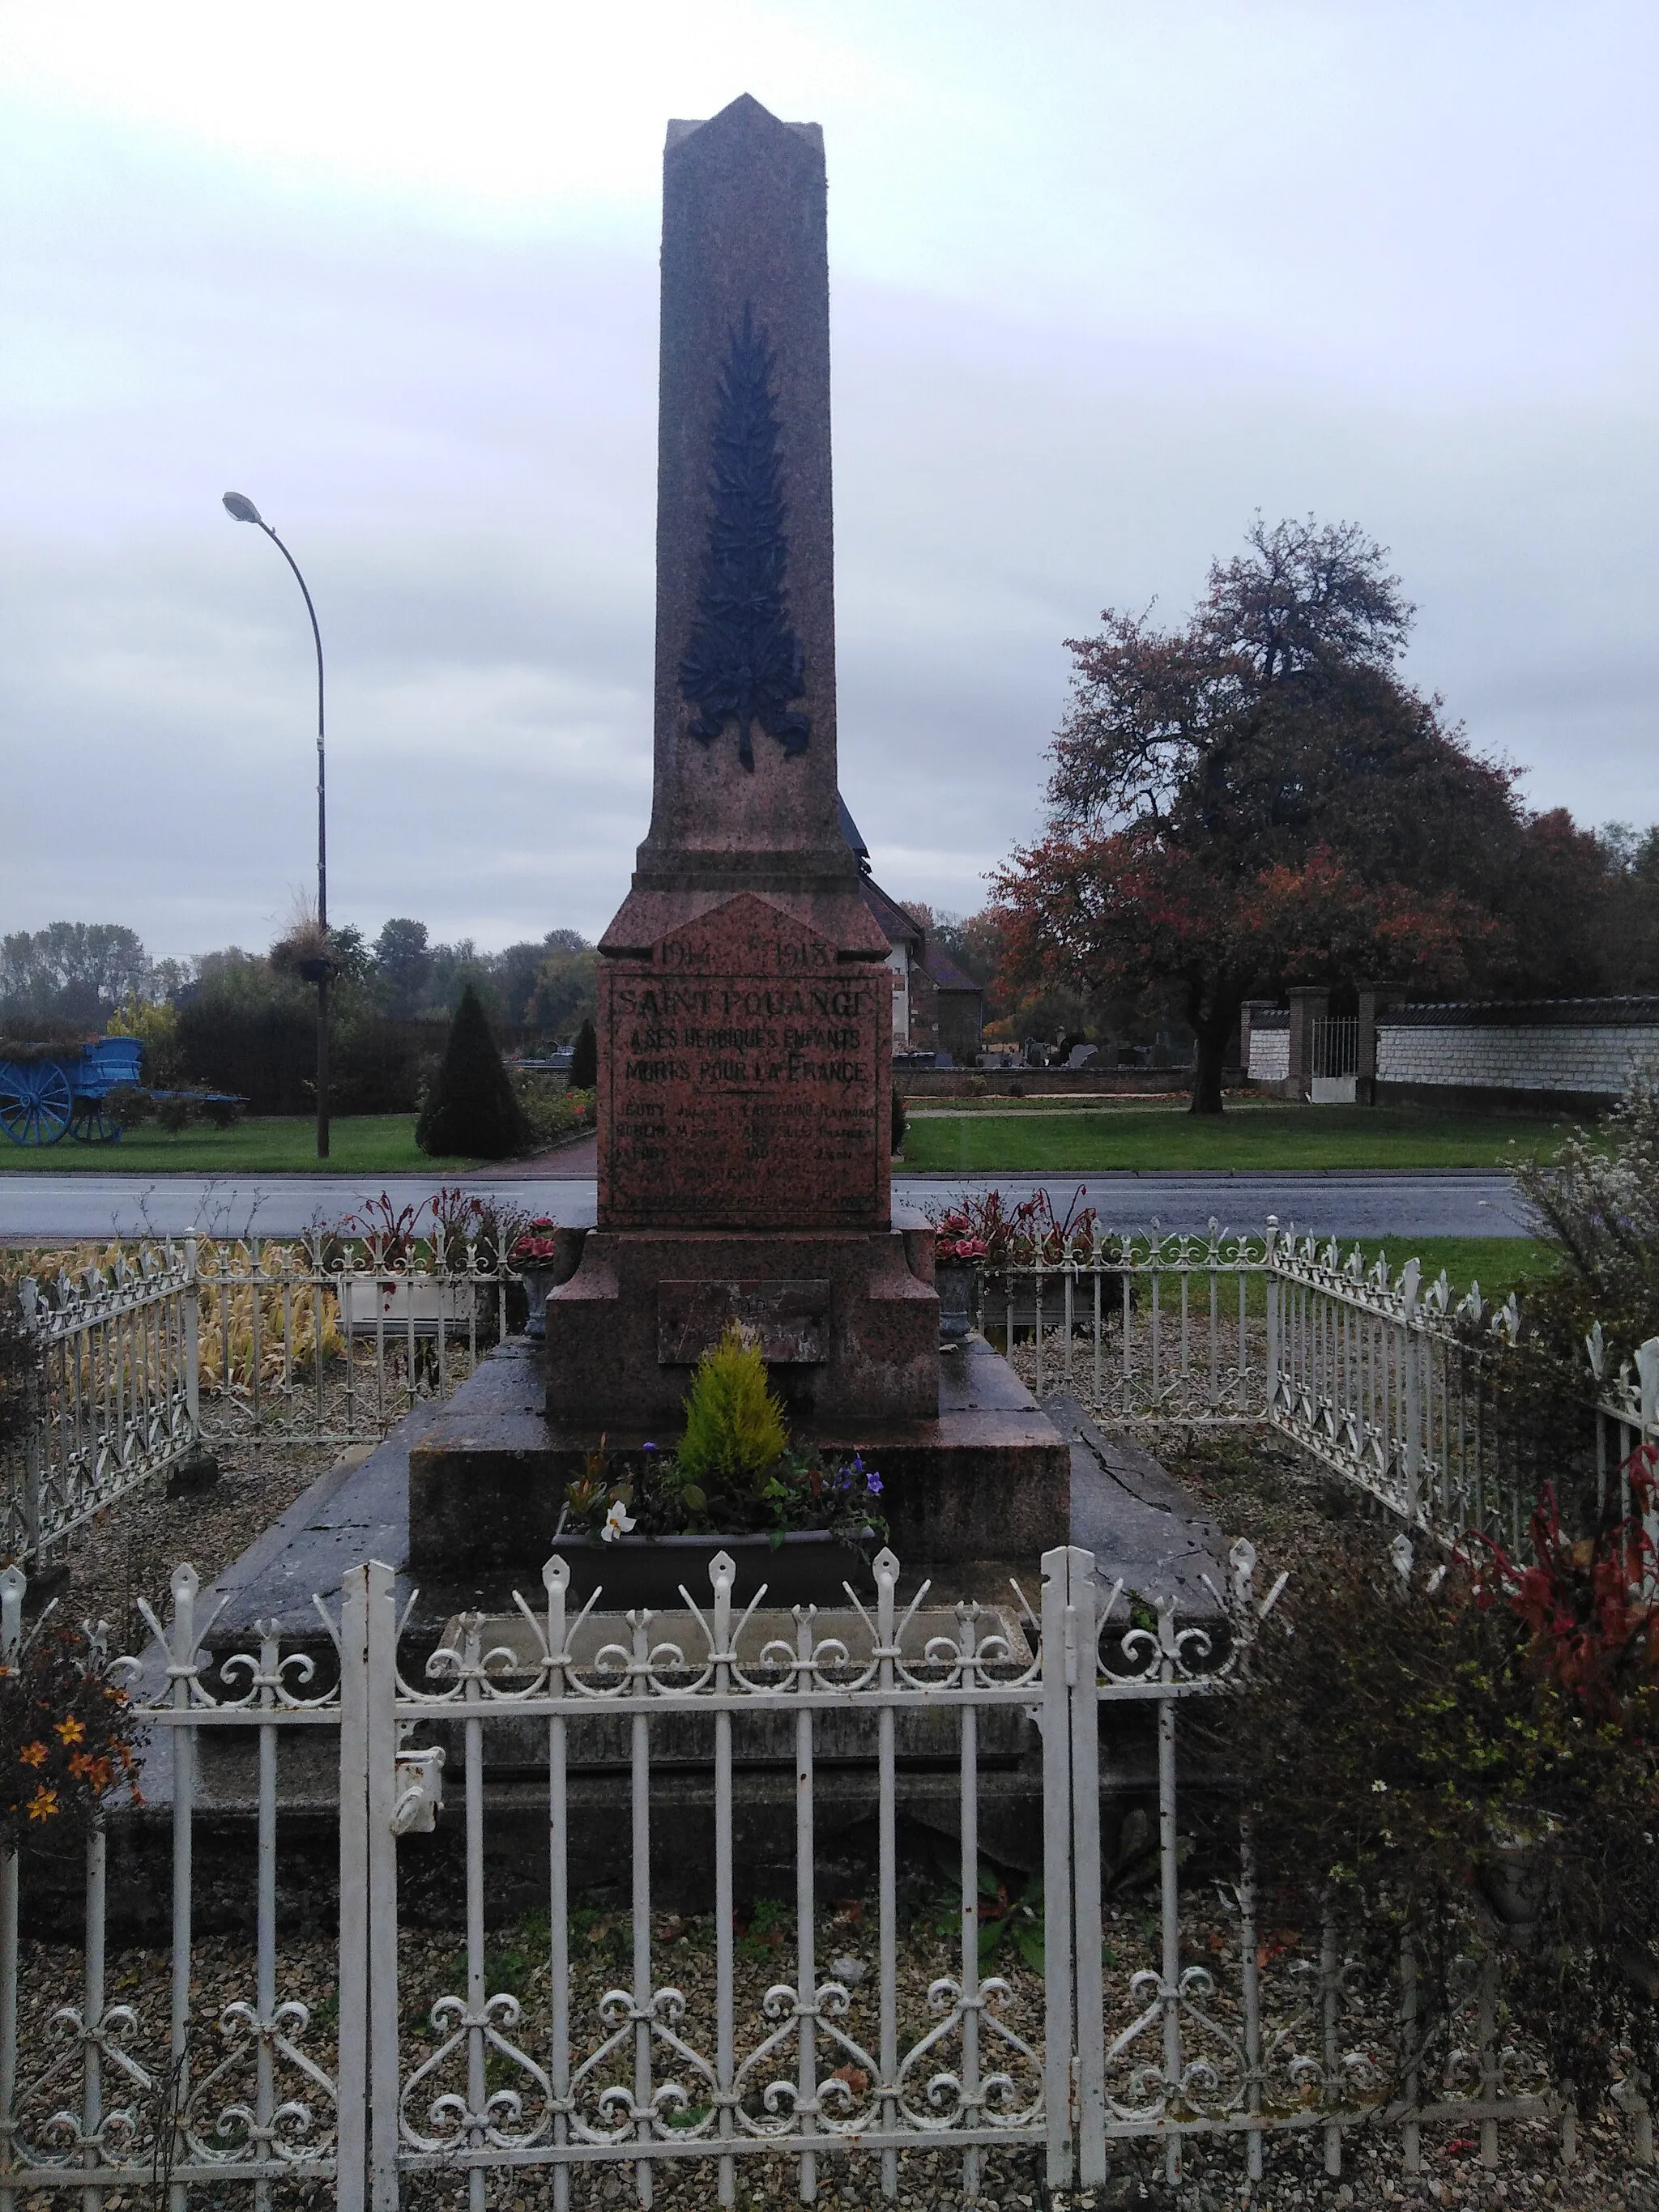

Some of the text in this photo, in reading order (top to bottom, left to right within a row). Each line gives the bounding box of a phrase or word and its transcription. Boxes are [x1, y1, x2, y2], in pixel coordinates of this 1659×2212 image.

[660, 941, 827, 968] 1914 1918
[618, 988, 872, 1017] SAINT POUANGE
[646, 1029, 677, 1051] SES
[784, 1029, 860, 1051] ENFANTS
[625, 1052, 868, 1084] MORTS POUR LA FRANCE
